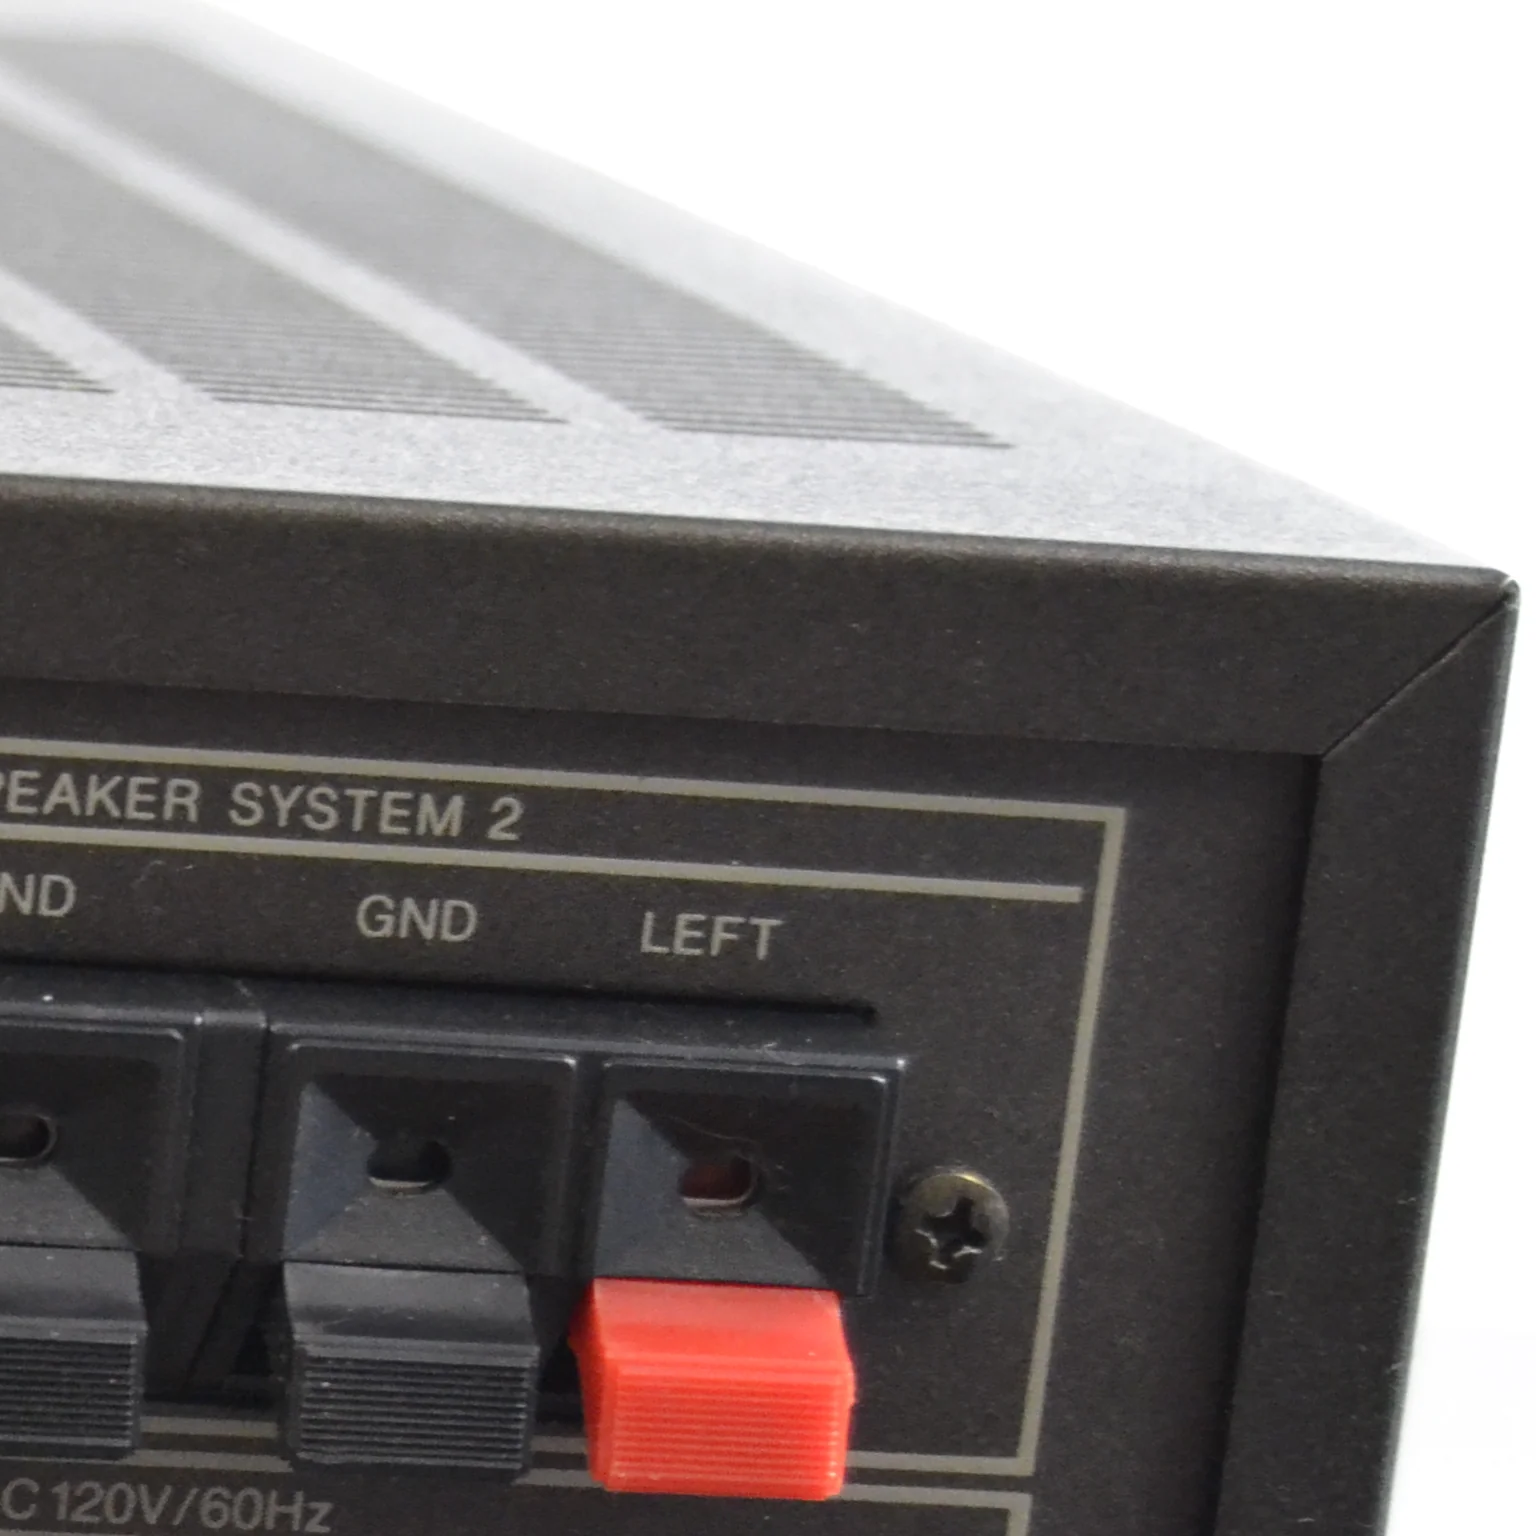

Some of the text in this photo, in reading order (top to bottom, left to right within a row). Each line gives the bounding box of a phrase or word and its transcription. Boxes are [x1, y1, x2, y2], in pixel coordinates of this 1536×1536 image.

[228, 782, 464, 838] SYSTEM
[487, 798, 521, 841] 2
[356, 896, 476, 943] GND
[640, 913, 780, 960] LEFT
